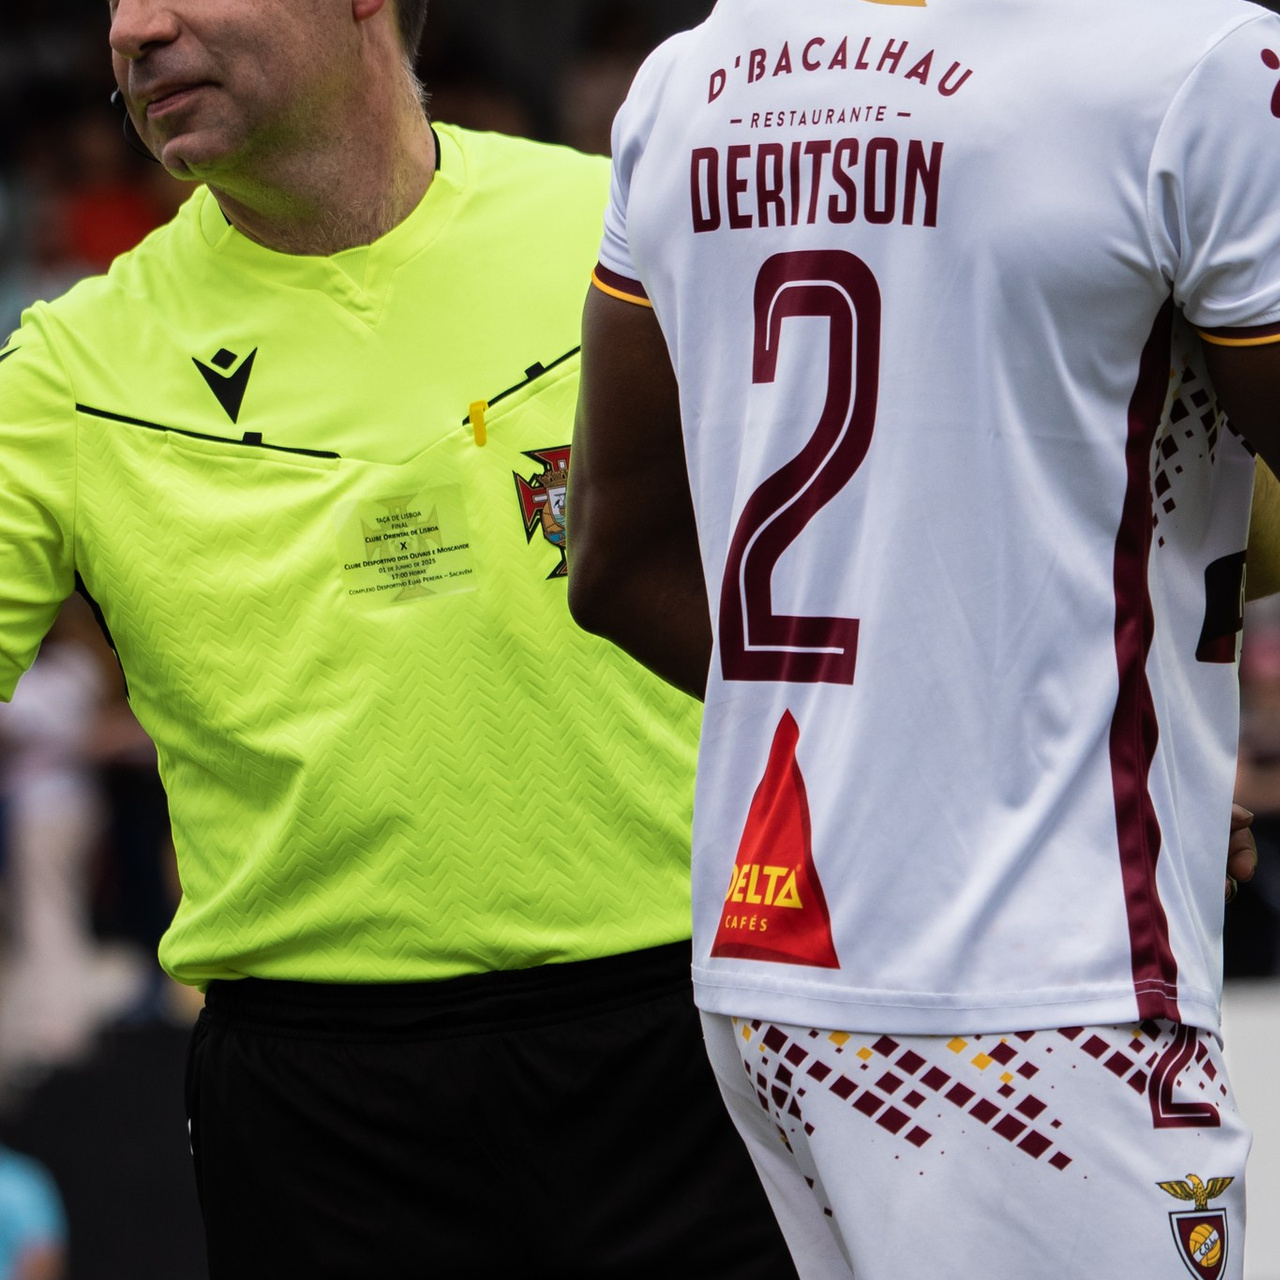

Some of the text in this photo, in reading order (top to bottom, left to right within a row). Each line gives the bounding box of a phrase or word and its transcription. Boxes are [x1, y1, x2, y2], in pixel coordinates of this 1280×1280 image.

[708, 36, 973, 104] D'BACALHAU
[751, 106, 887, 128] RESTAURANTE
[690, 137, 944, 233] DERITSON
[718, 249, 882, 686] 2
[725, 915, 767, 932] CAFÉS
